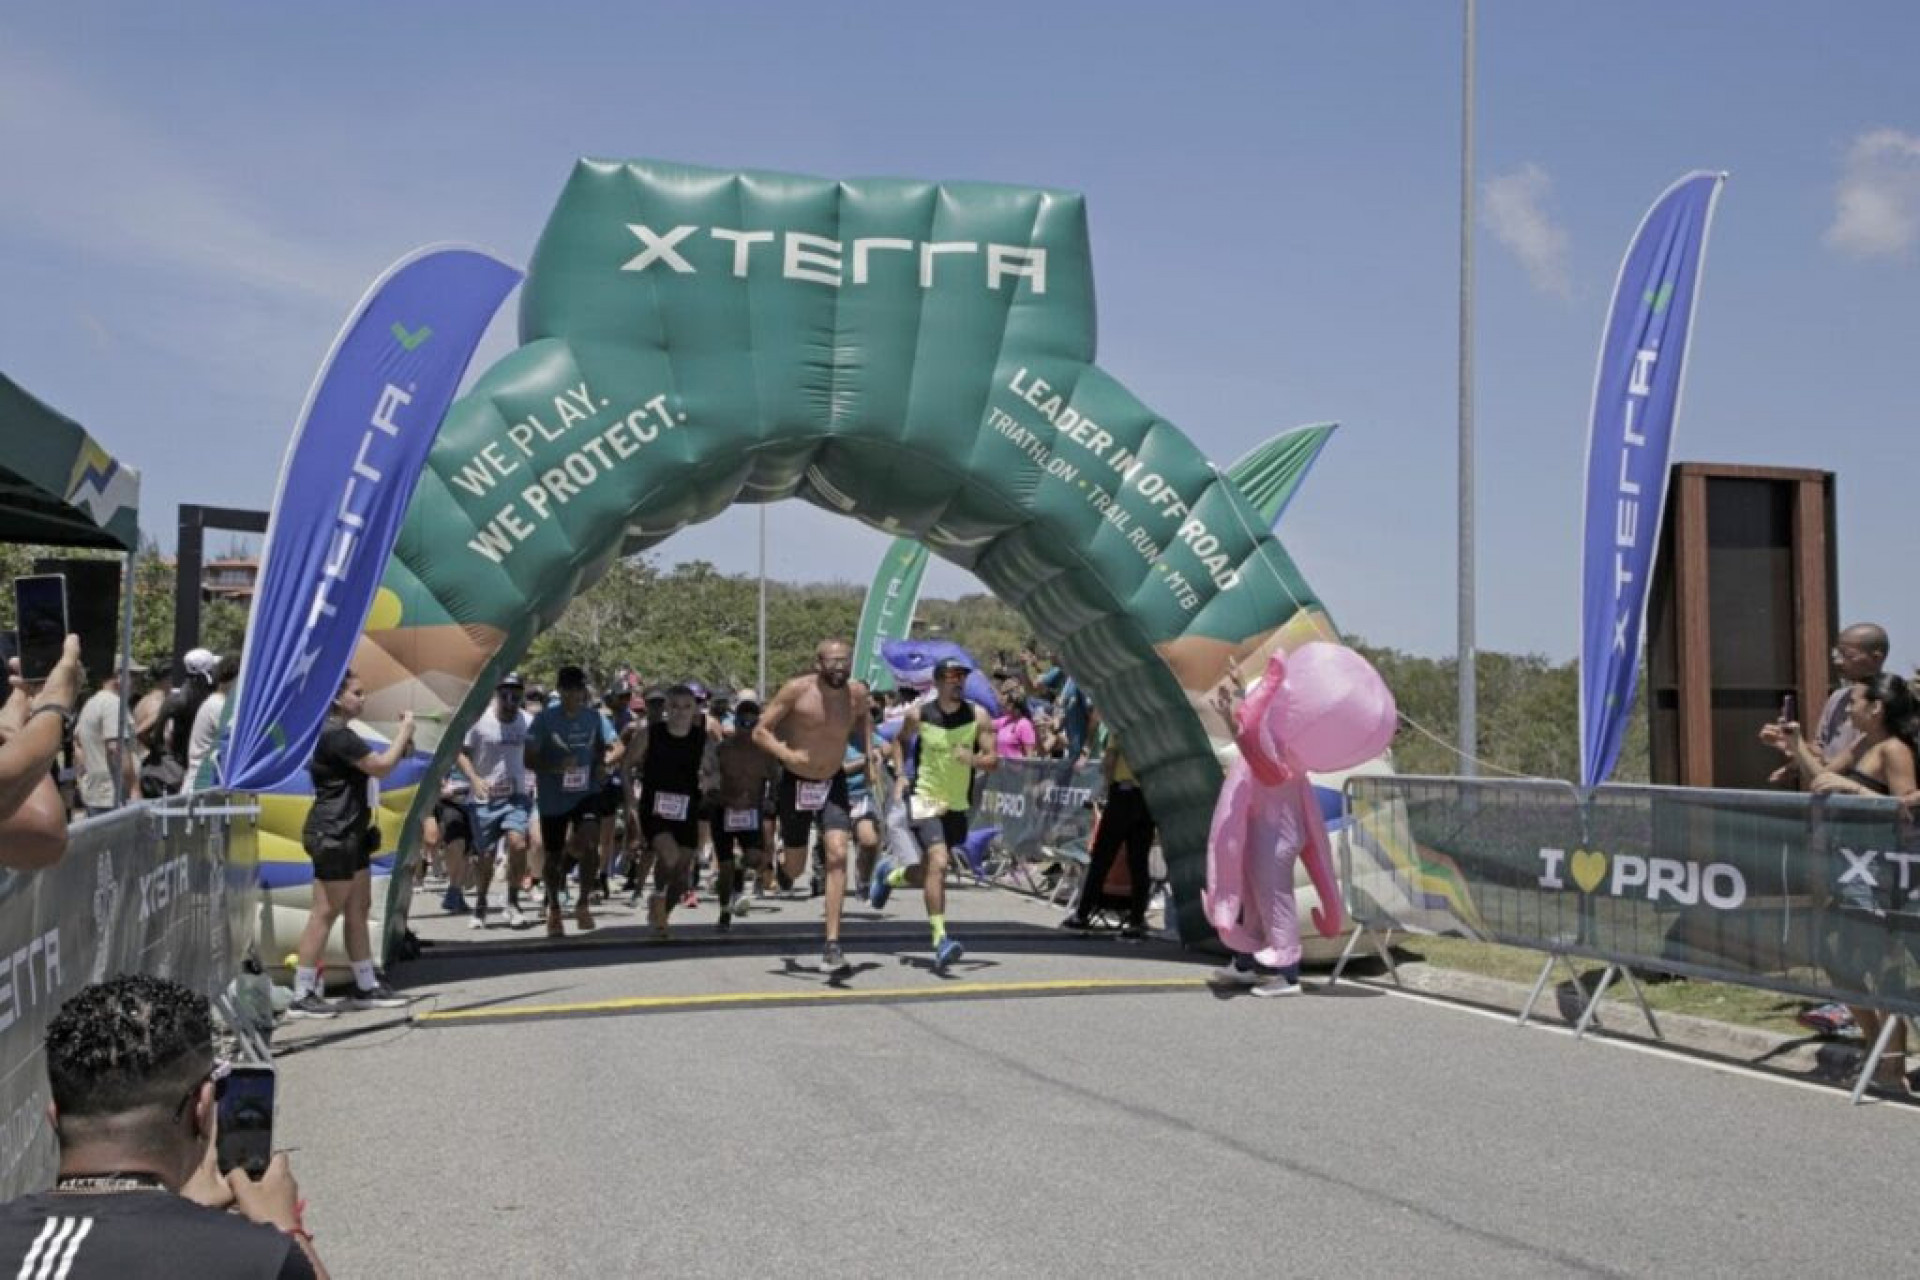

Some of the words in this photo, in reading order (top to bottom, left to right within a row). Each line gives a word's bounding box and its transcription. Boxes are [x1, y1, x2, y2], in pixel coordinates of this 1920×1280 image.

[621, 224, 1047, 294] XTERRA
[452, 441, 520, 497] WE
[507, 382, 610, 458] PLAY.
[467, 503, 536, 564] WE
[521, 393, 687, 519] PROTECT.
[987, 406, 1079, 483] TRIATHLON
[1087, 486, 1134, 531] TRAIL
[1128, 525, 1160, 565] RUN
[1163, 571, 1199, 610] MTB
[1008, 367, 1113, 457] LEADER
[1107, 447, 1144, 483] IN
[1136, 473, 1190, 518] OFF
[1177, 519, 1240, 591] ROAD
[1613, 349, 1659, 656] XTERRA
[1538, 848, 1564, 888] I
[1610, 854, 1747, 909] PRIO
